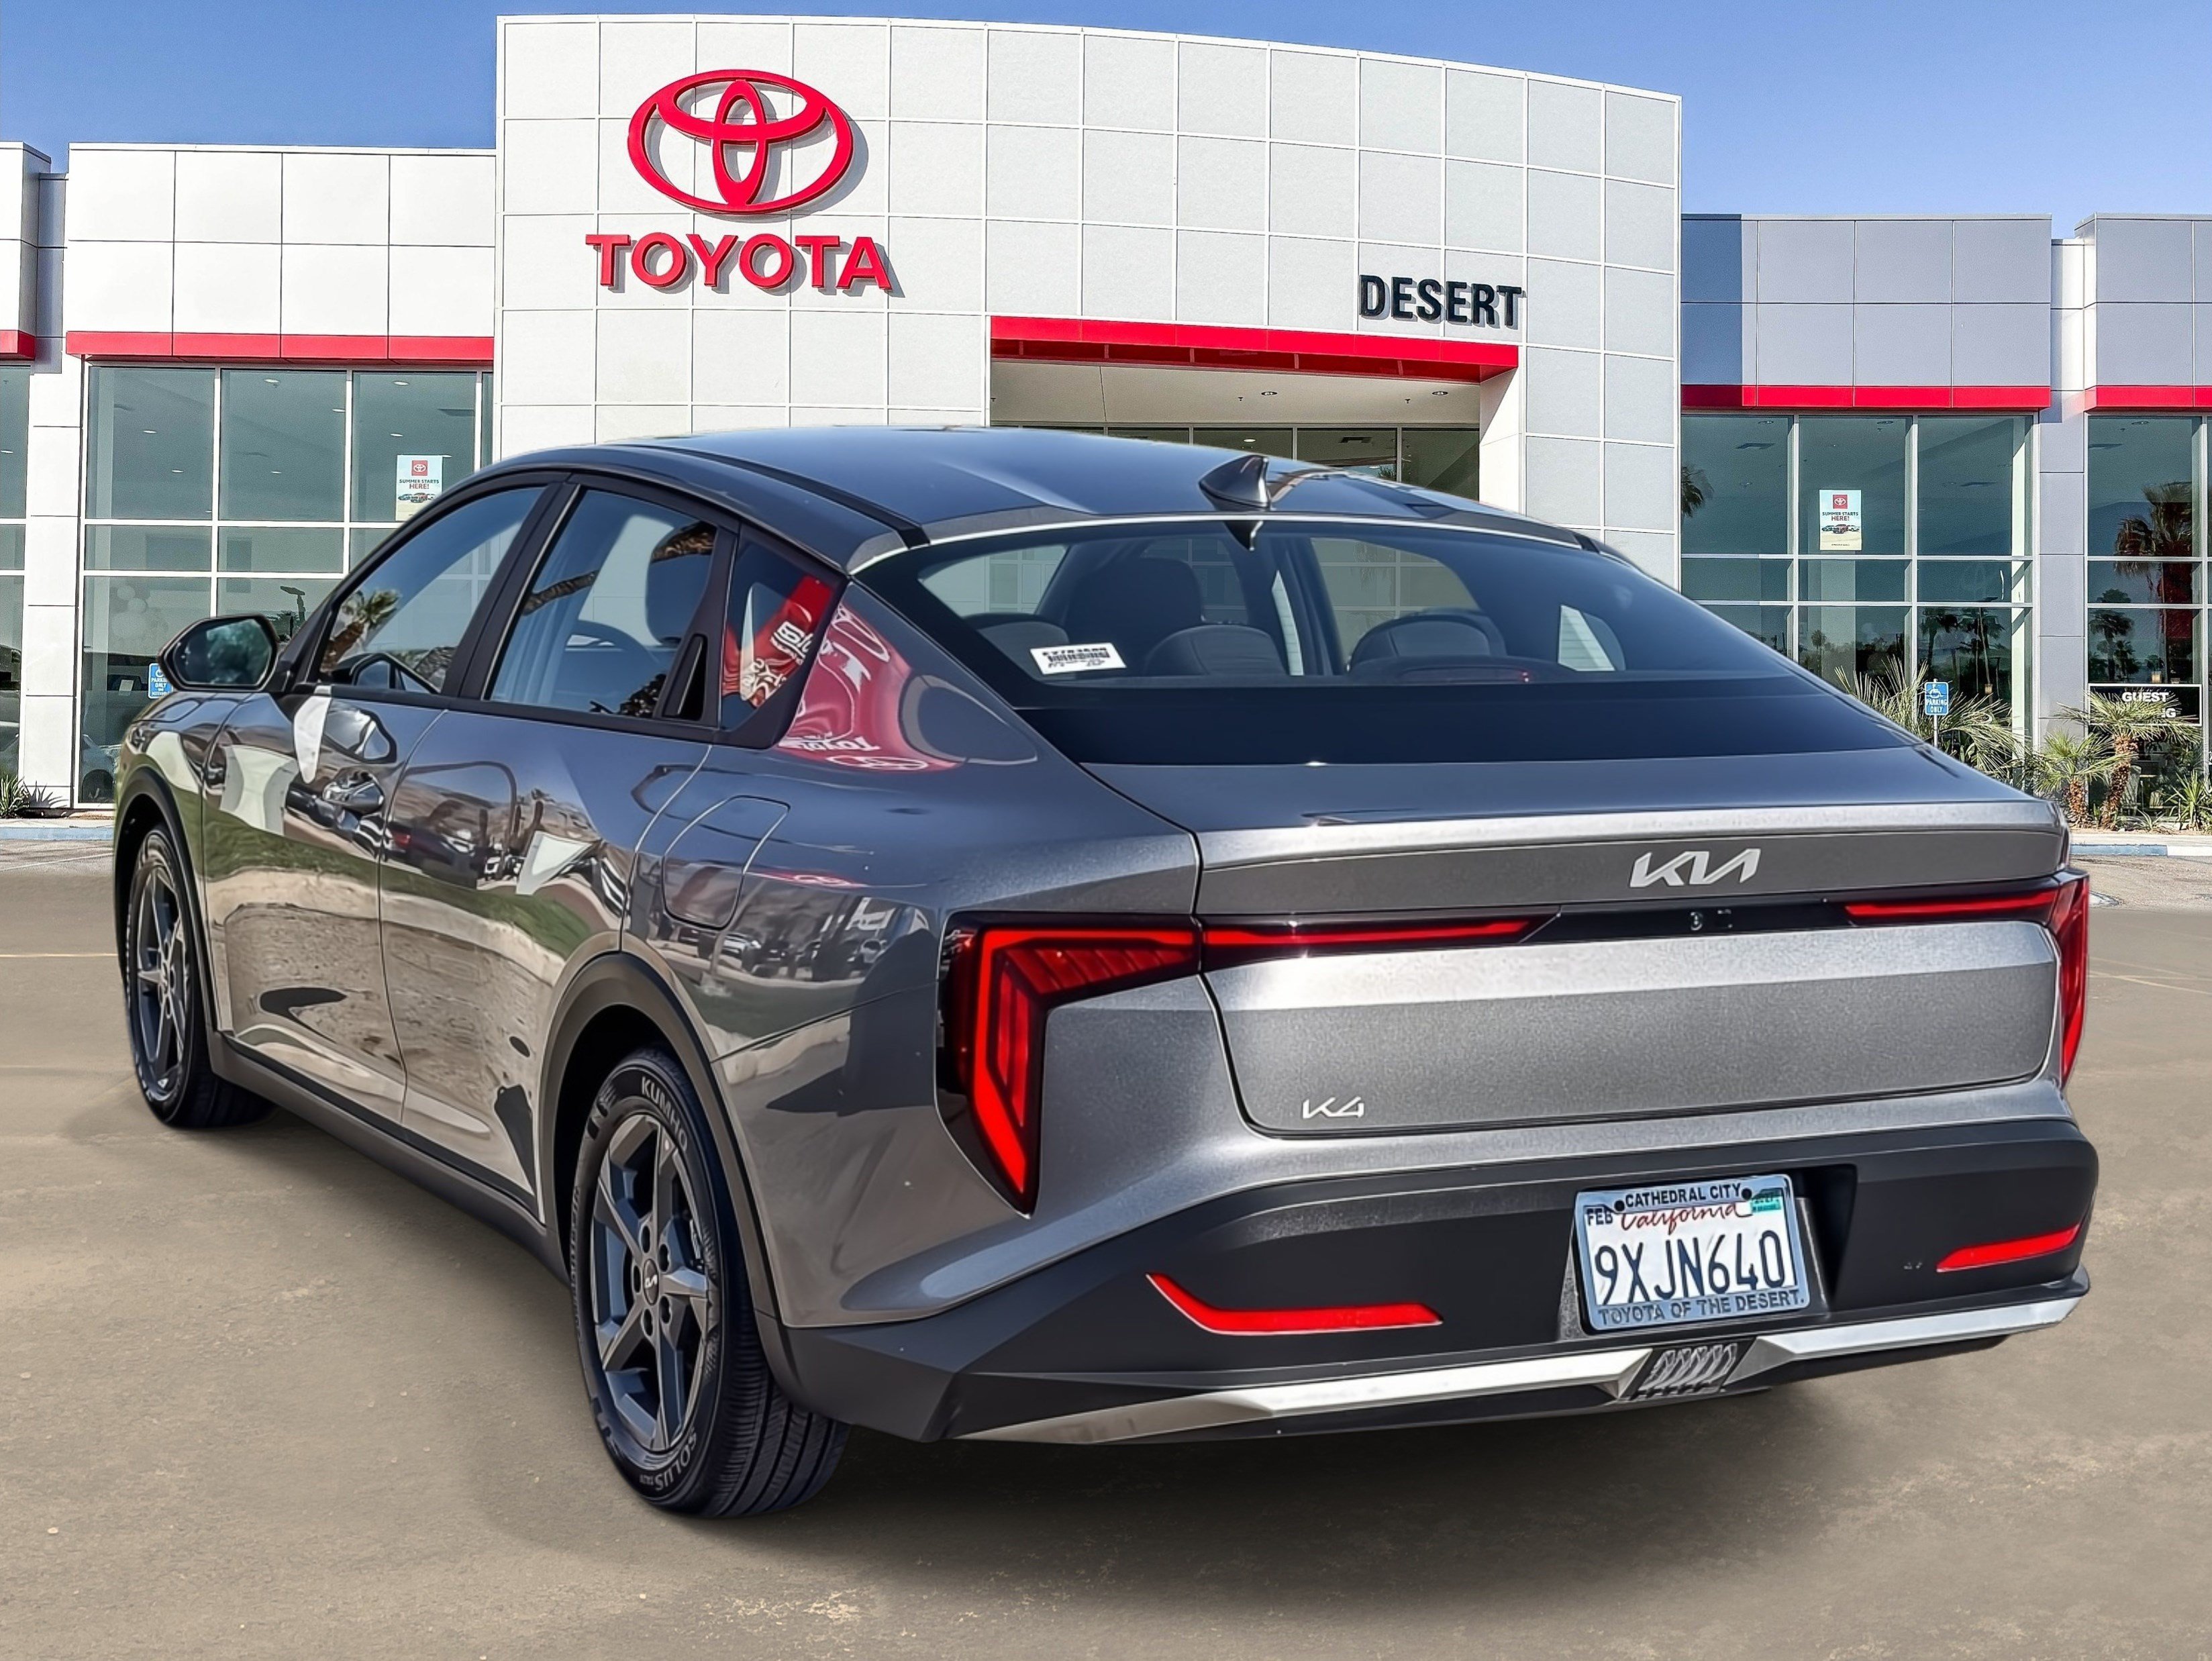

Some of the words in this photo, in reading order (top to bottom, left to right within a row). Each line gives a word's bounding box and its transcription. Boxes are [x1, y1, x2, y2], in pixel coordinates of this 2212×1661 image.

[586, 232, 892, 291] TOYOTA
[1358, 274, 1522, 327] DESERT
[2122, 691, 2169, 703] GUEST
[1629, 848, 1762, 888] KIA
[642, 1076, 688, 1152] KUMHO
[1302, 1096, 1364, 1119] K4
[1625, 1187, 1707, 1208] CATHEDRAL
[1709, 1182, 1742, 1199] CITY
[1587, 1209, 1613, 1226] FEB
[1595, 1230, 1786, 1305] 9XJN640
[1597, 1304, 1666, 1325] TOYOTA
[1670, 1301, 1692, 1319] OF
[1696, 1297, 1731, 1315] THE
[654, 1427, 697, 1491] SOLUS
